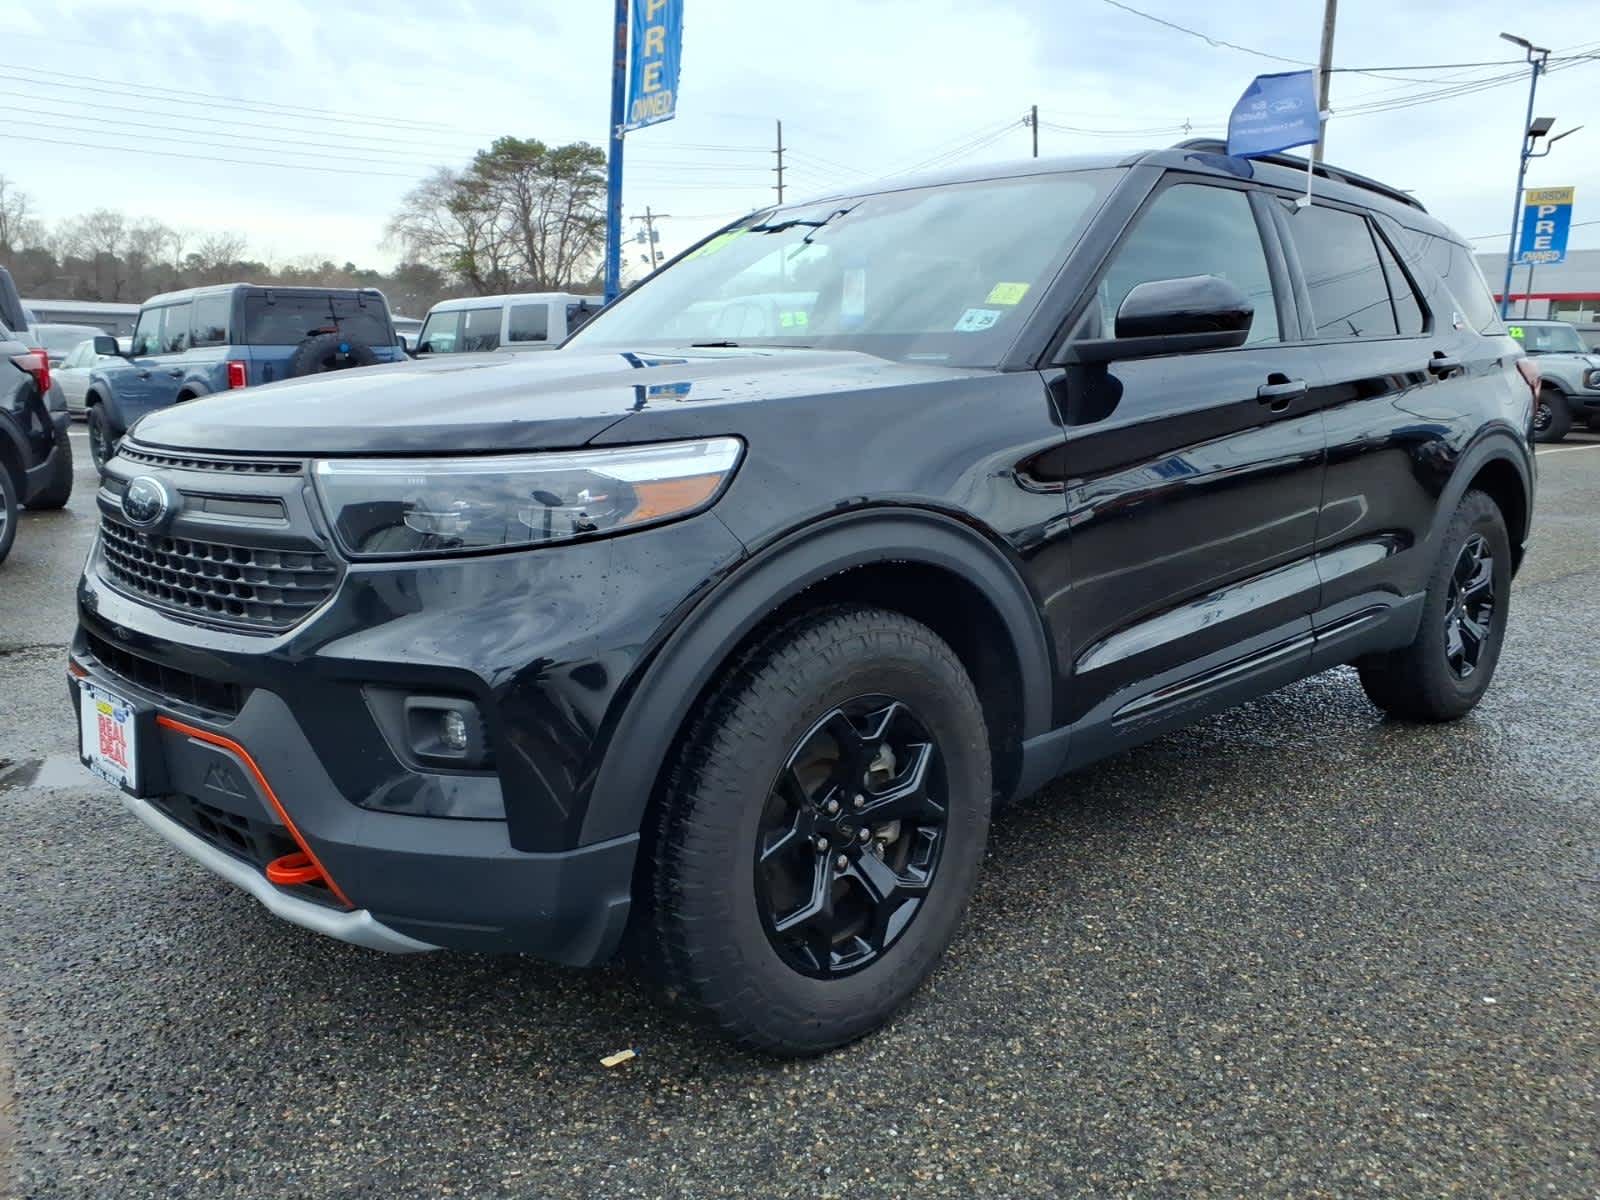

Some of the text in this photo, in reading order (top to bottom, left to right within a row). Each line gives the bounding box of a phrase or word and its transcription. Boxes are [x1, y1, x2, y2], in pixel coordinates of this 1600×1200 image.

[643, 0, 666, 93] PRE
[1534, 205, 1558, 250] PRE
[98, 714, 127, 748] REAL
